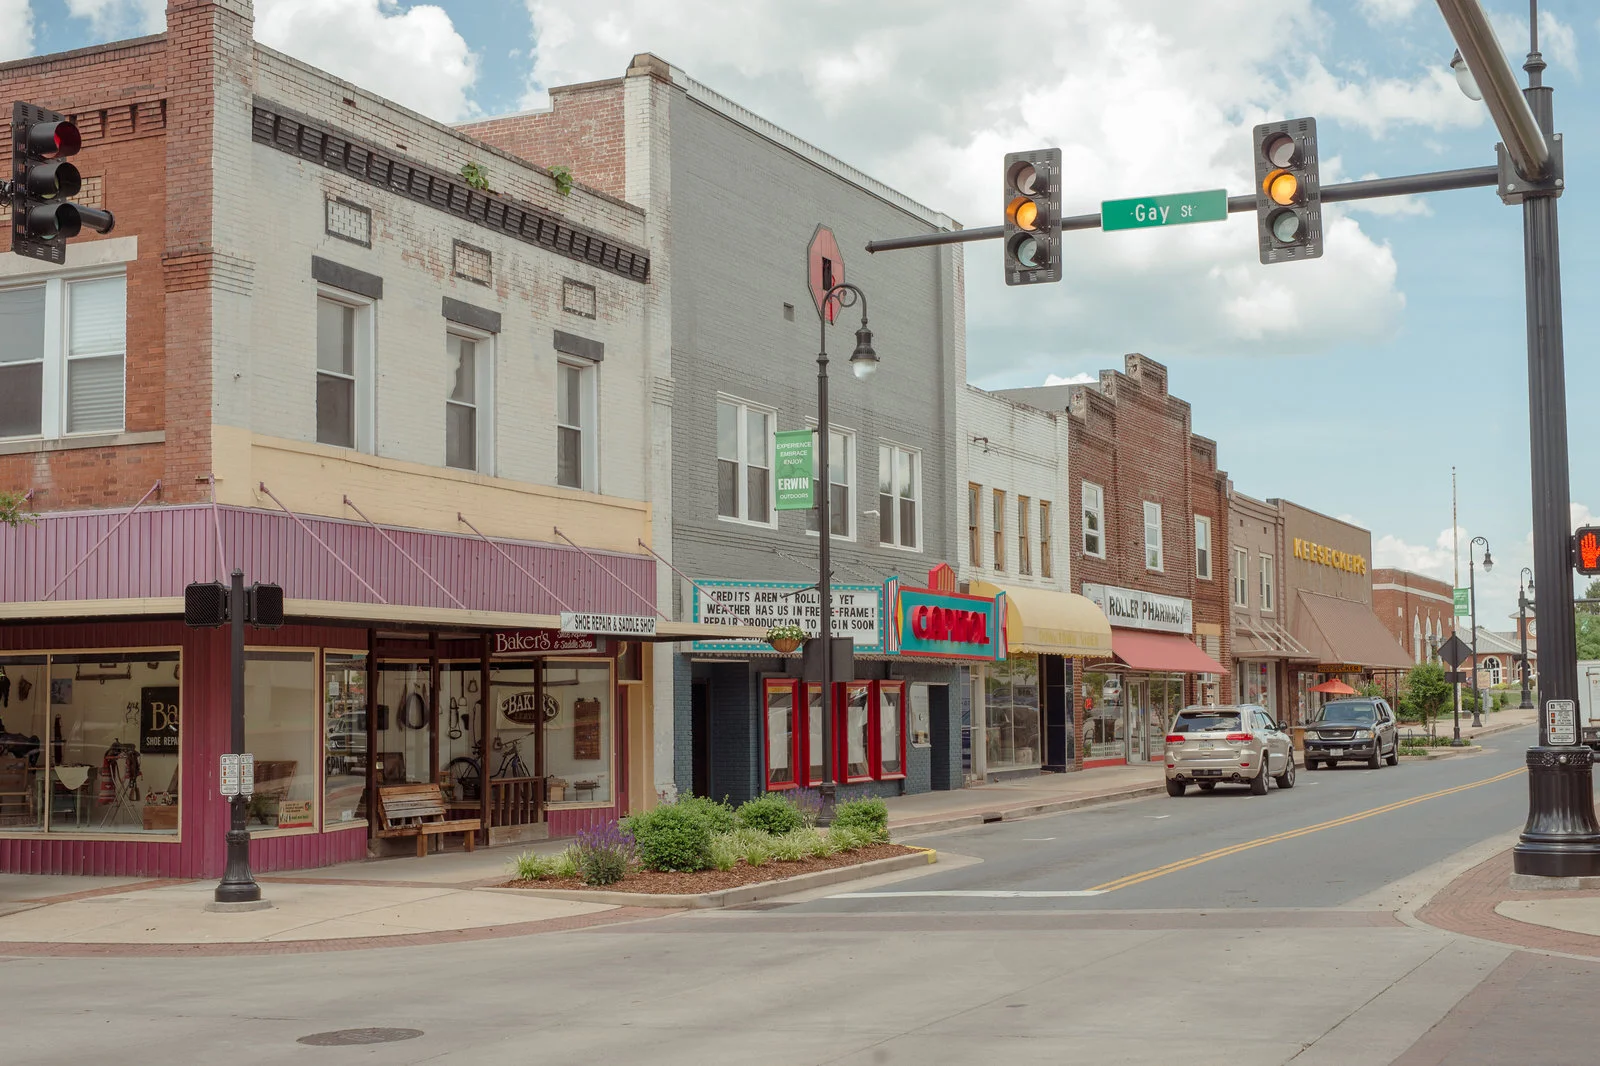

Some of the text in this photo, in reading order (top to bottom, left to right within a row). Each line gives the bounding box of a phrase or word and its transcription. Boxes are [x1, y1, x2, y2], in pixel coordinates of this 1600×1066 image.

[1135, 204, 1193, 224] Gay St
[776, 441, 812, 449] EXPERIENCE
[778, 477, 809, 490] ERWIN
[1293, 537, 1367, 575] KEESECKER'S
[711, 591, 750, 602] CREDITS
[795, 593, 833, 605] ROLLIG
[840, 594, 855, 605] YET
[707, 604, 750, 615] WEATHER
[755, 605, 774, 616] HAS
[777, 605, 789, 616] US
[793, 606, 802, 616] IN
[1109, 596, 1184, 625] ROLLER PHARMACY
[574, 614, 591, 630] SHOE
[592, 615, 612, 631] REPAIR
[613, 617, 617, 631] &
[619, 617, 639, 632] SADDLE
[640, 618, 655, 633] SHOP
[704, 617, 738, 626] REPAIR
[744, 618, 800, 628] PRODUCTION
[805, 619, 817, 629] TO
[851, 620, 874, 630] SOON
[495, 630, 551, 652] Baker's
[560, 640, 578, 649] Saddle
[578, 639, 593, 648] Shop
[146, 736, 161, 746] SHOE
